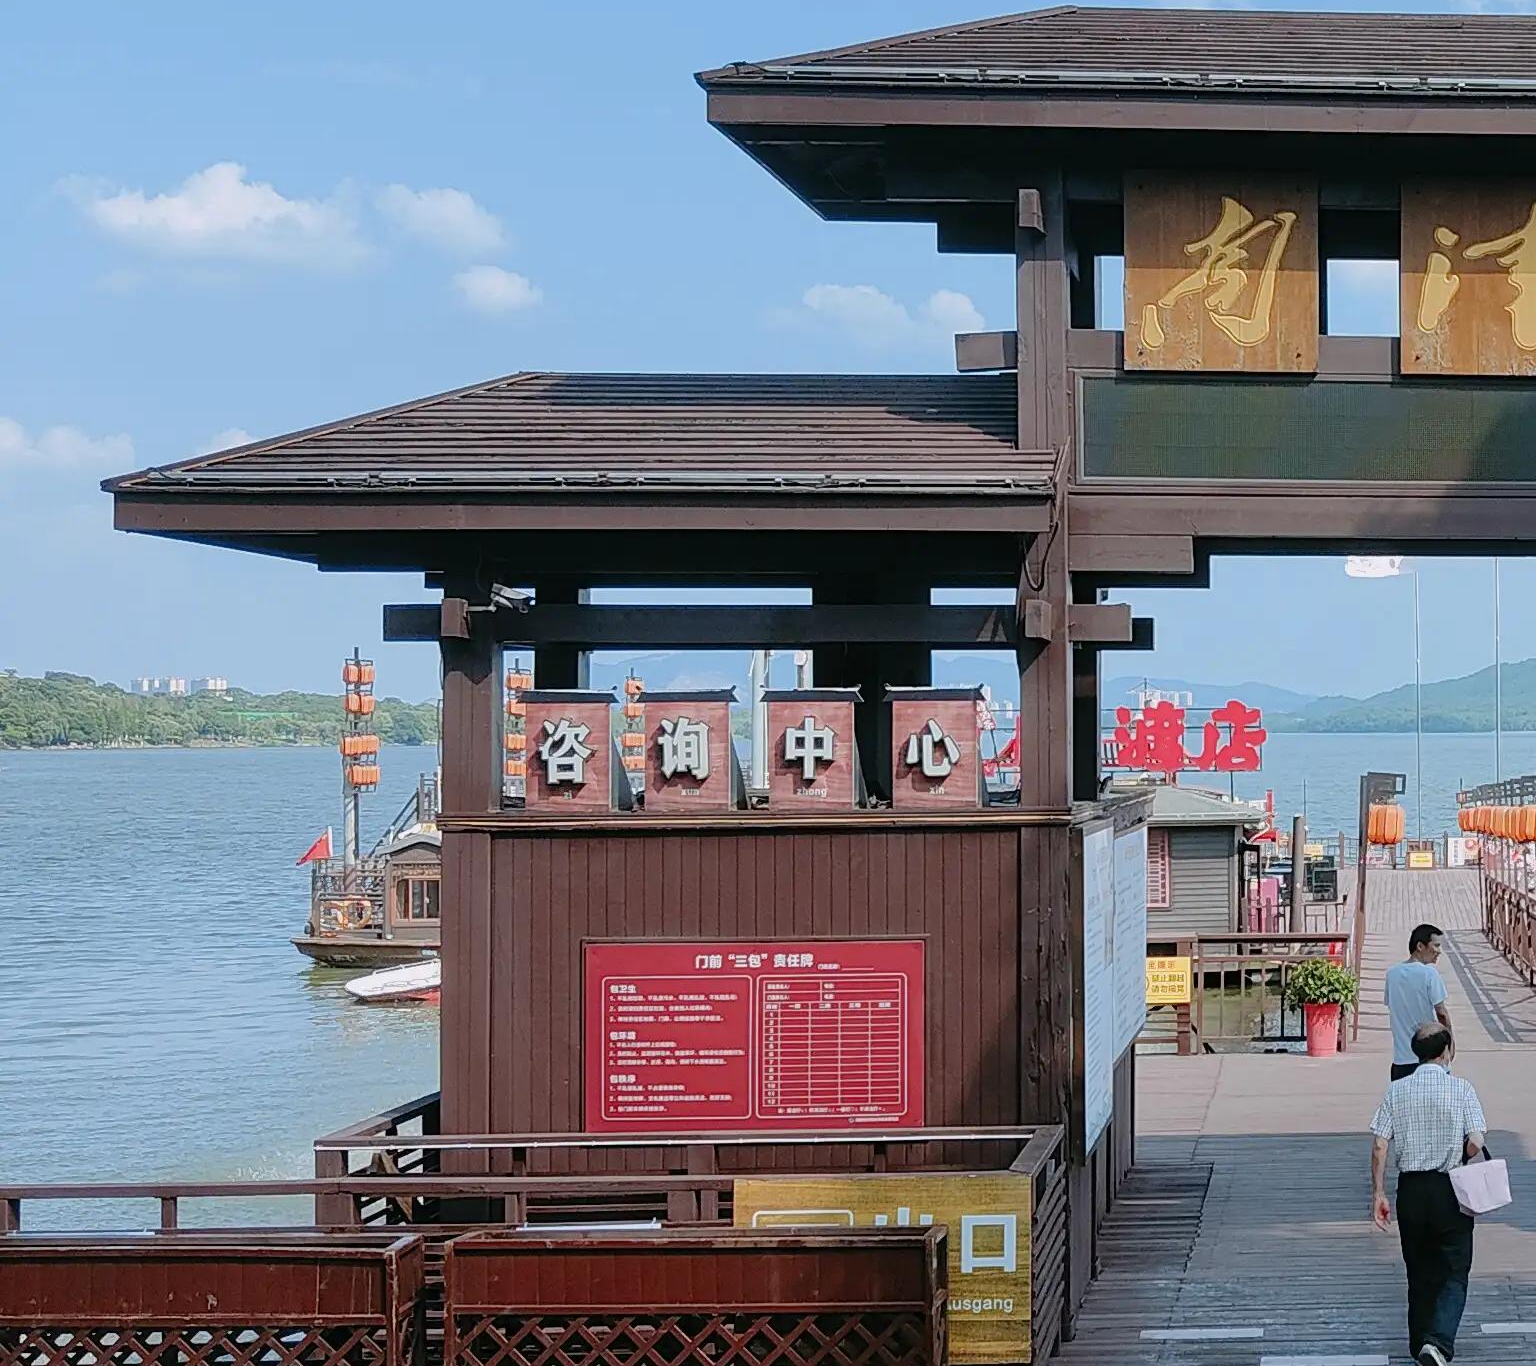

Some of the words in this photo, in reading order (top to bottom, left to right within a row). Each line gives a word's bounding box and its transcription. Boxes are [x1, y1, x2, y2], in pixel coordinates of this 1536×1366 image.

[539, 716, 961, 785] 咨询中心
[797, 786, 828, 797] zhong
[928, 785, 945, 795] xin
